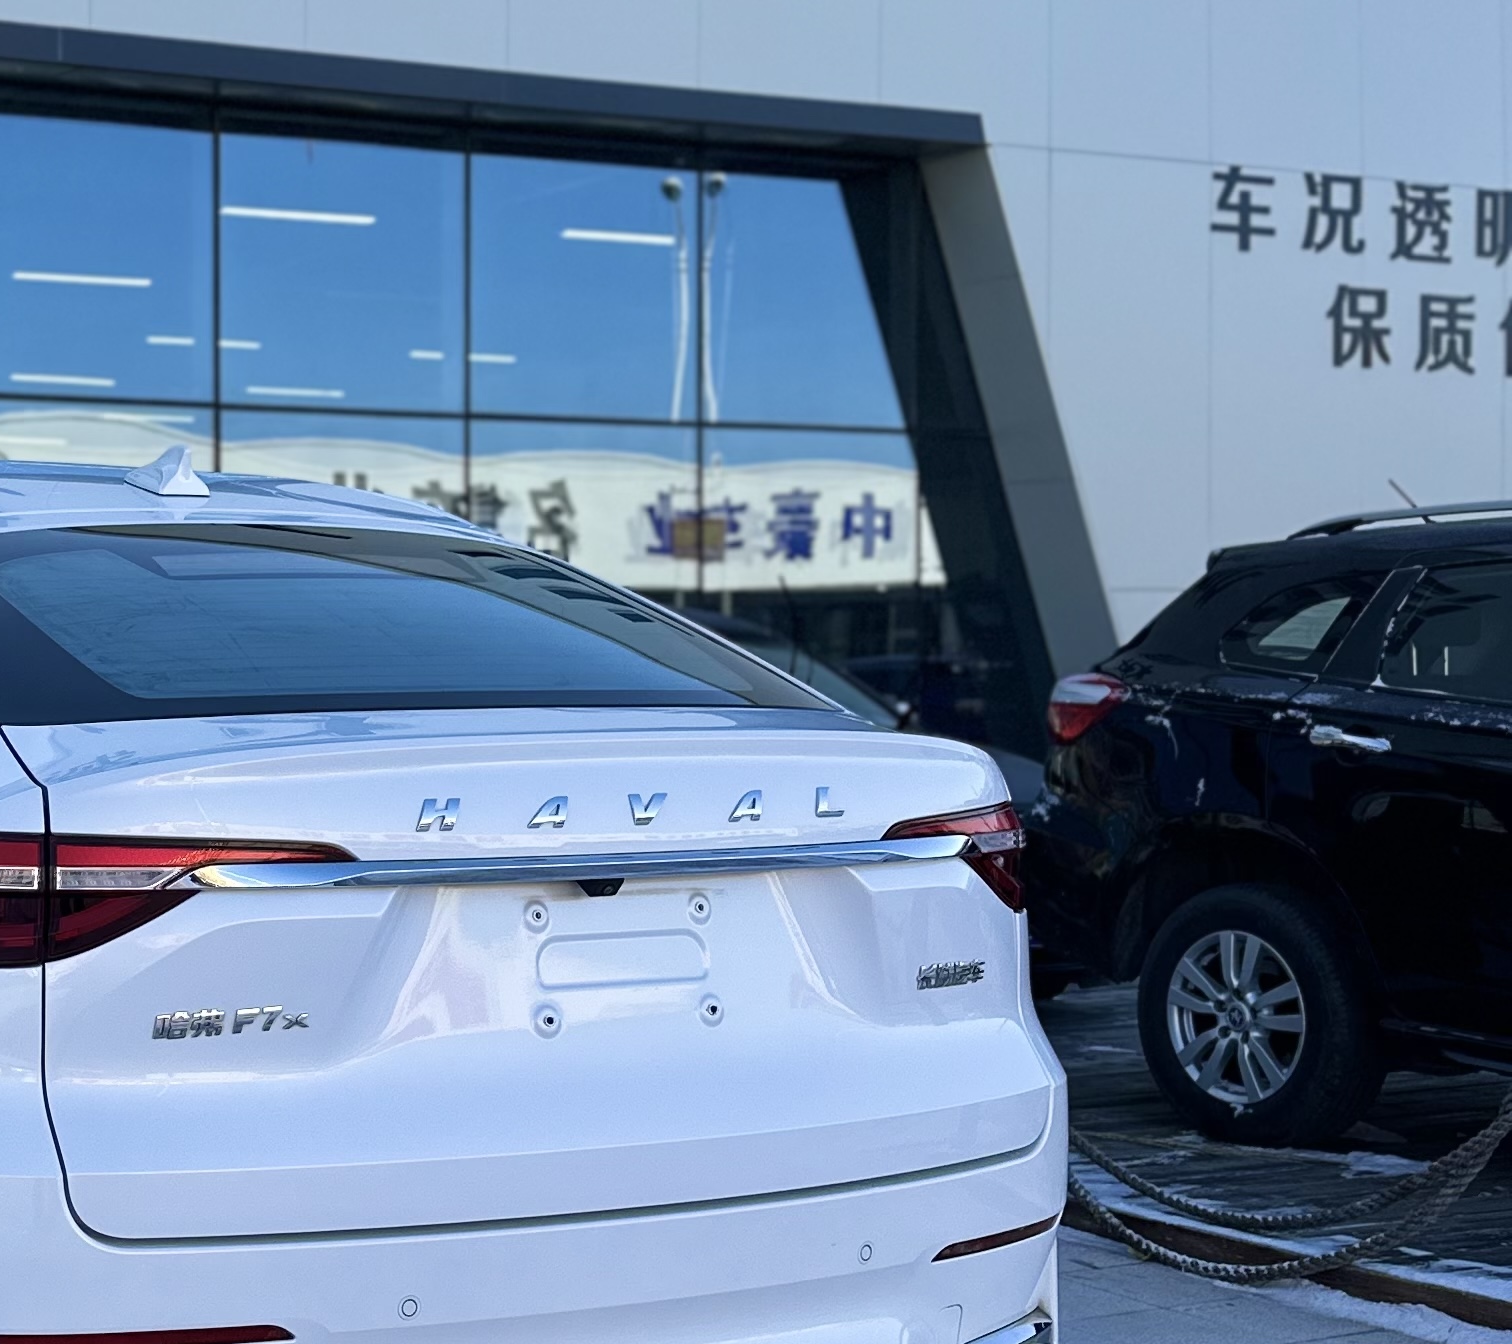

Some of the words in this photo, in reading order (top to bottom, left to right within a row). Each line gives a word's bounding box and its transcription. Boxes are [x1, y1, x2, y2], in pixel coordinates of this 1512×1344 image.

[1326, 283, 1512, 378] 保质
[416, 786, 845, 832] HAVAL
[152, 1008, 226, 1040] 哈弗
